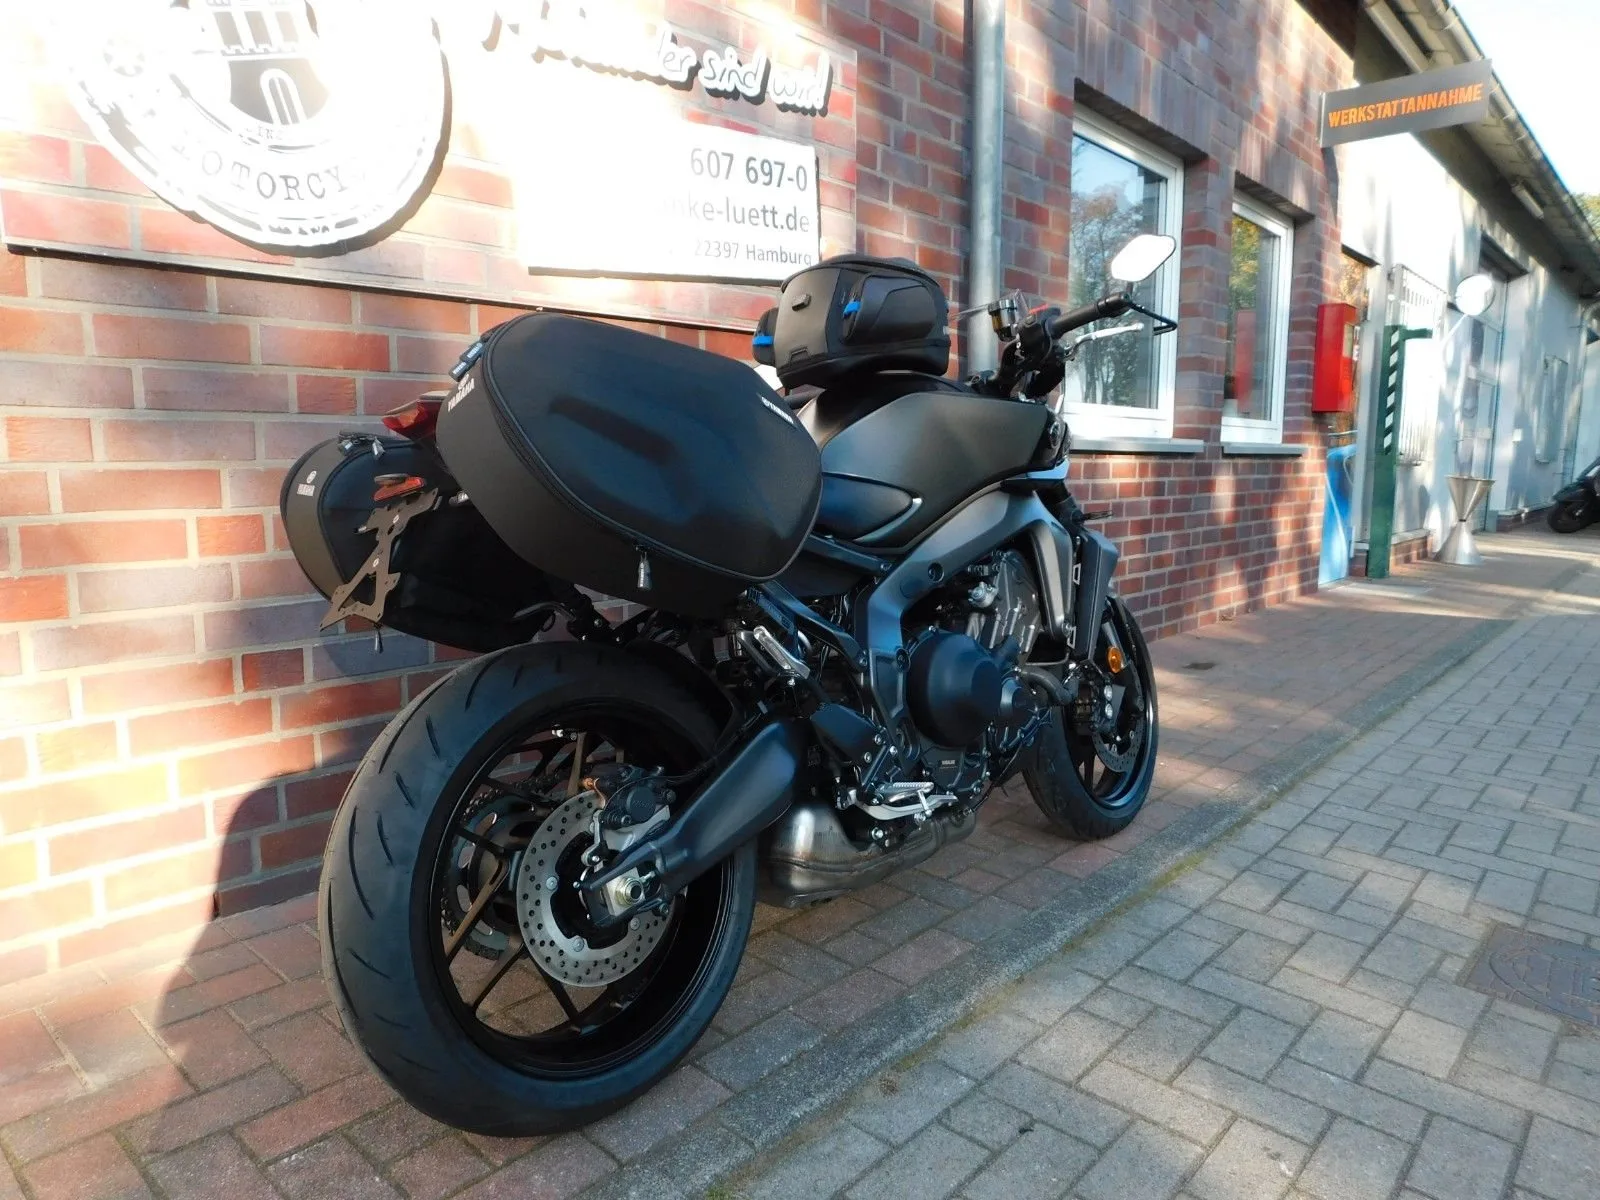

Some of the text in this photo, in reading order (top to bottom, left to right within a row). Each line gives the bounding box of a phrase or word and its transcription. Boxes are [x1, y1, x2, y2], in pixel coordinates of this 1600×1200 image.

[703, 55, 763, 88] sind
[1328, 83, 1484, 128] WERKSTATTANNAHME
[690, 147, 807, 192] 607 697-0
[694, 238, 739, 259] 22397
